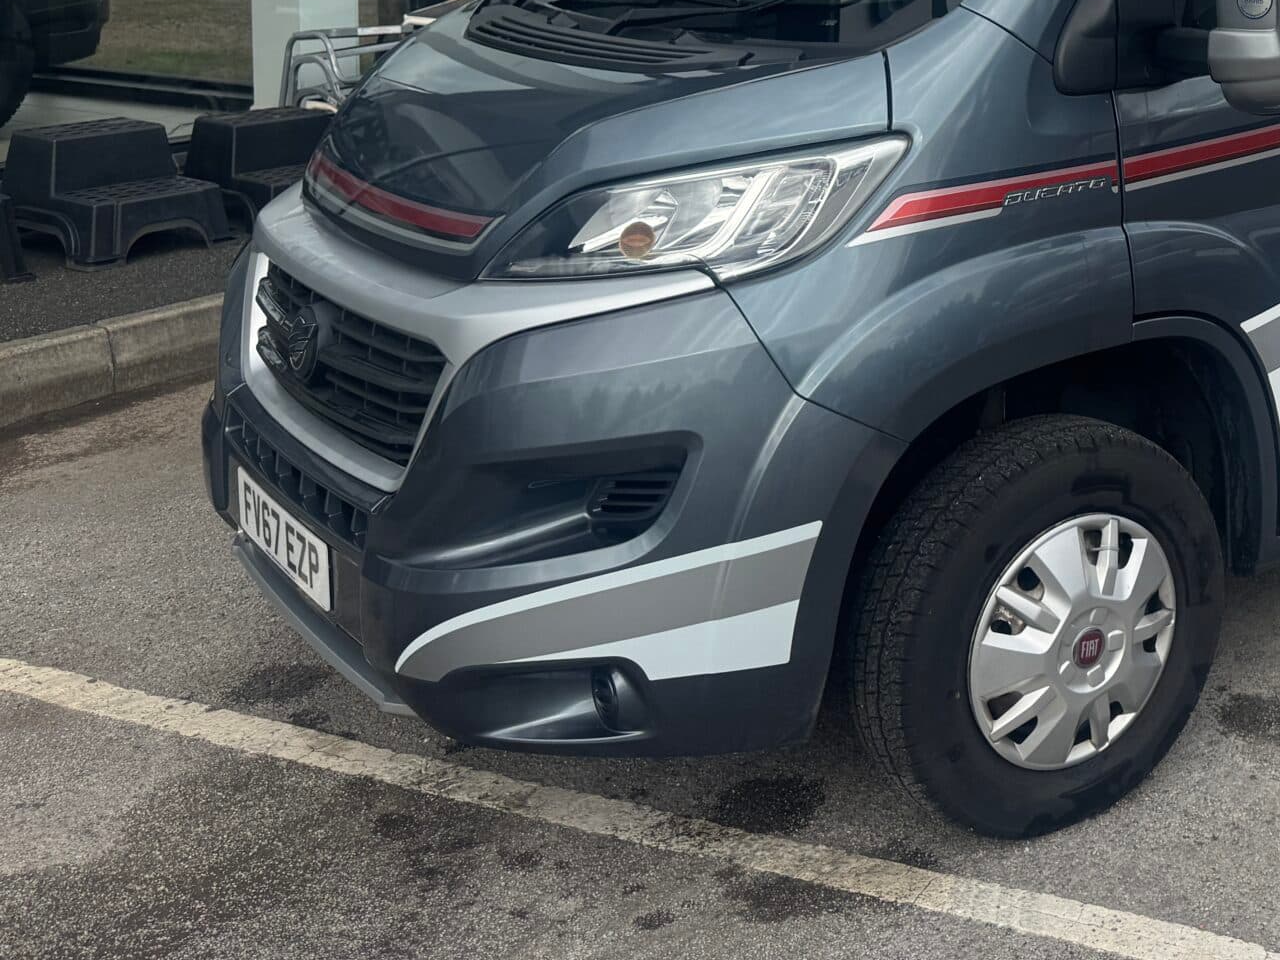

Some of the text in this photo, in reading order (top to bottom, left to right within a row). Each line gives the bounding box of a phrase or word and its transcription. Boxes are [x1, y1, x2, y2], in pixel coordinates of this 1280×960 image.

[1005, 177, 1106, 206] DUCATO
[243, 480, 281, 556] FV67
[285, 520, 320, 590] EZP
[1080, 638, 1100, 659] FIAT
